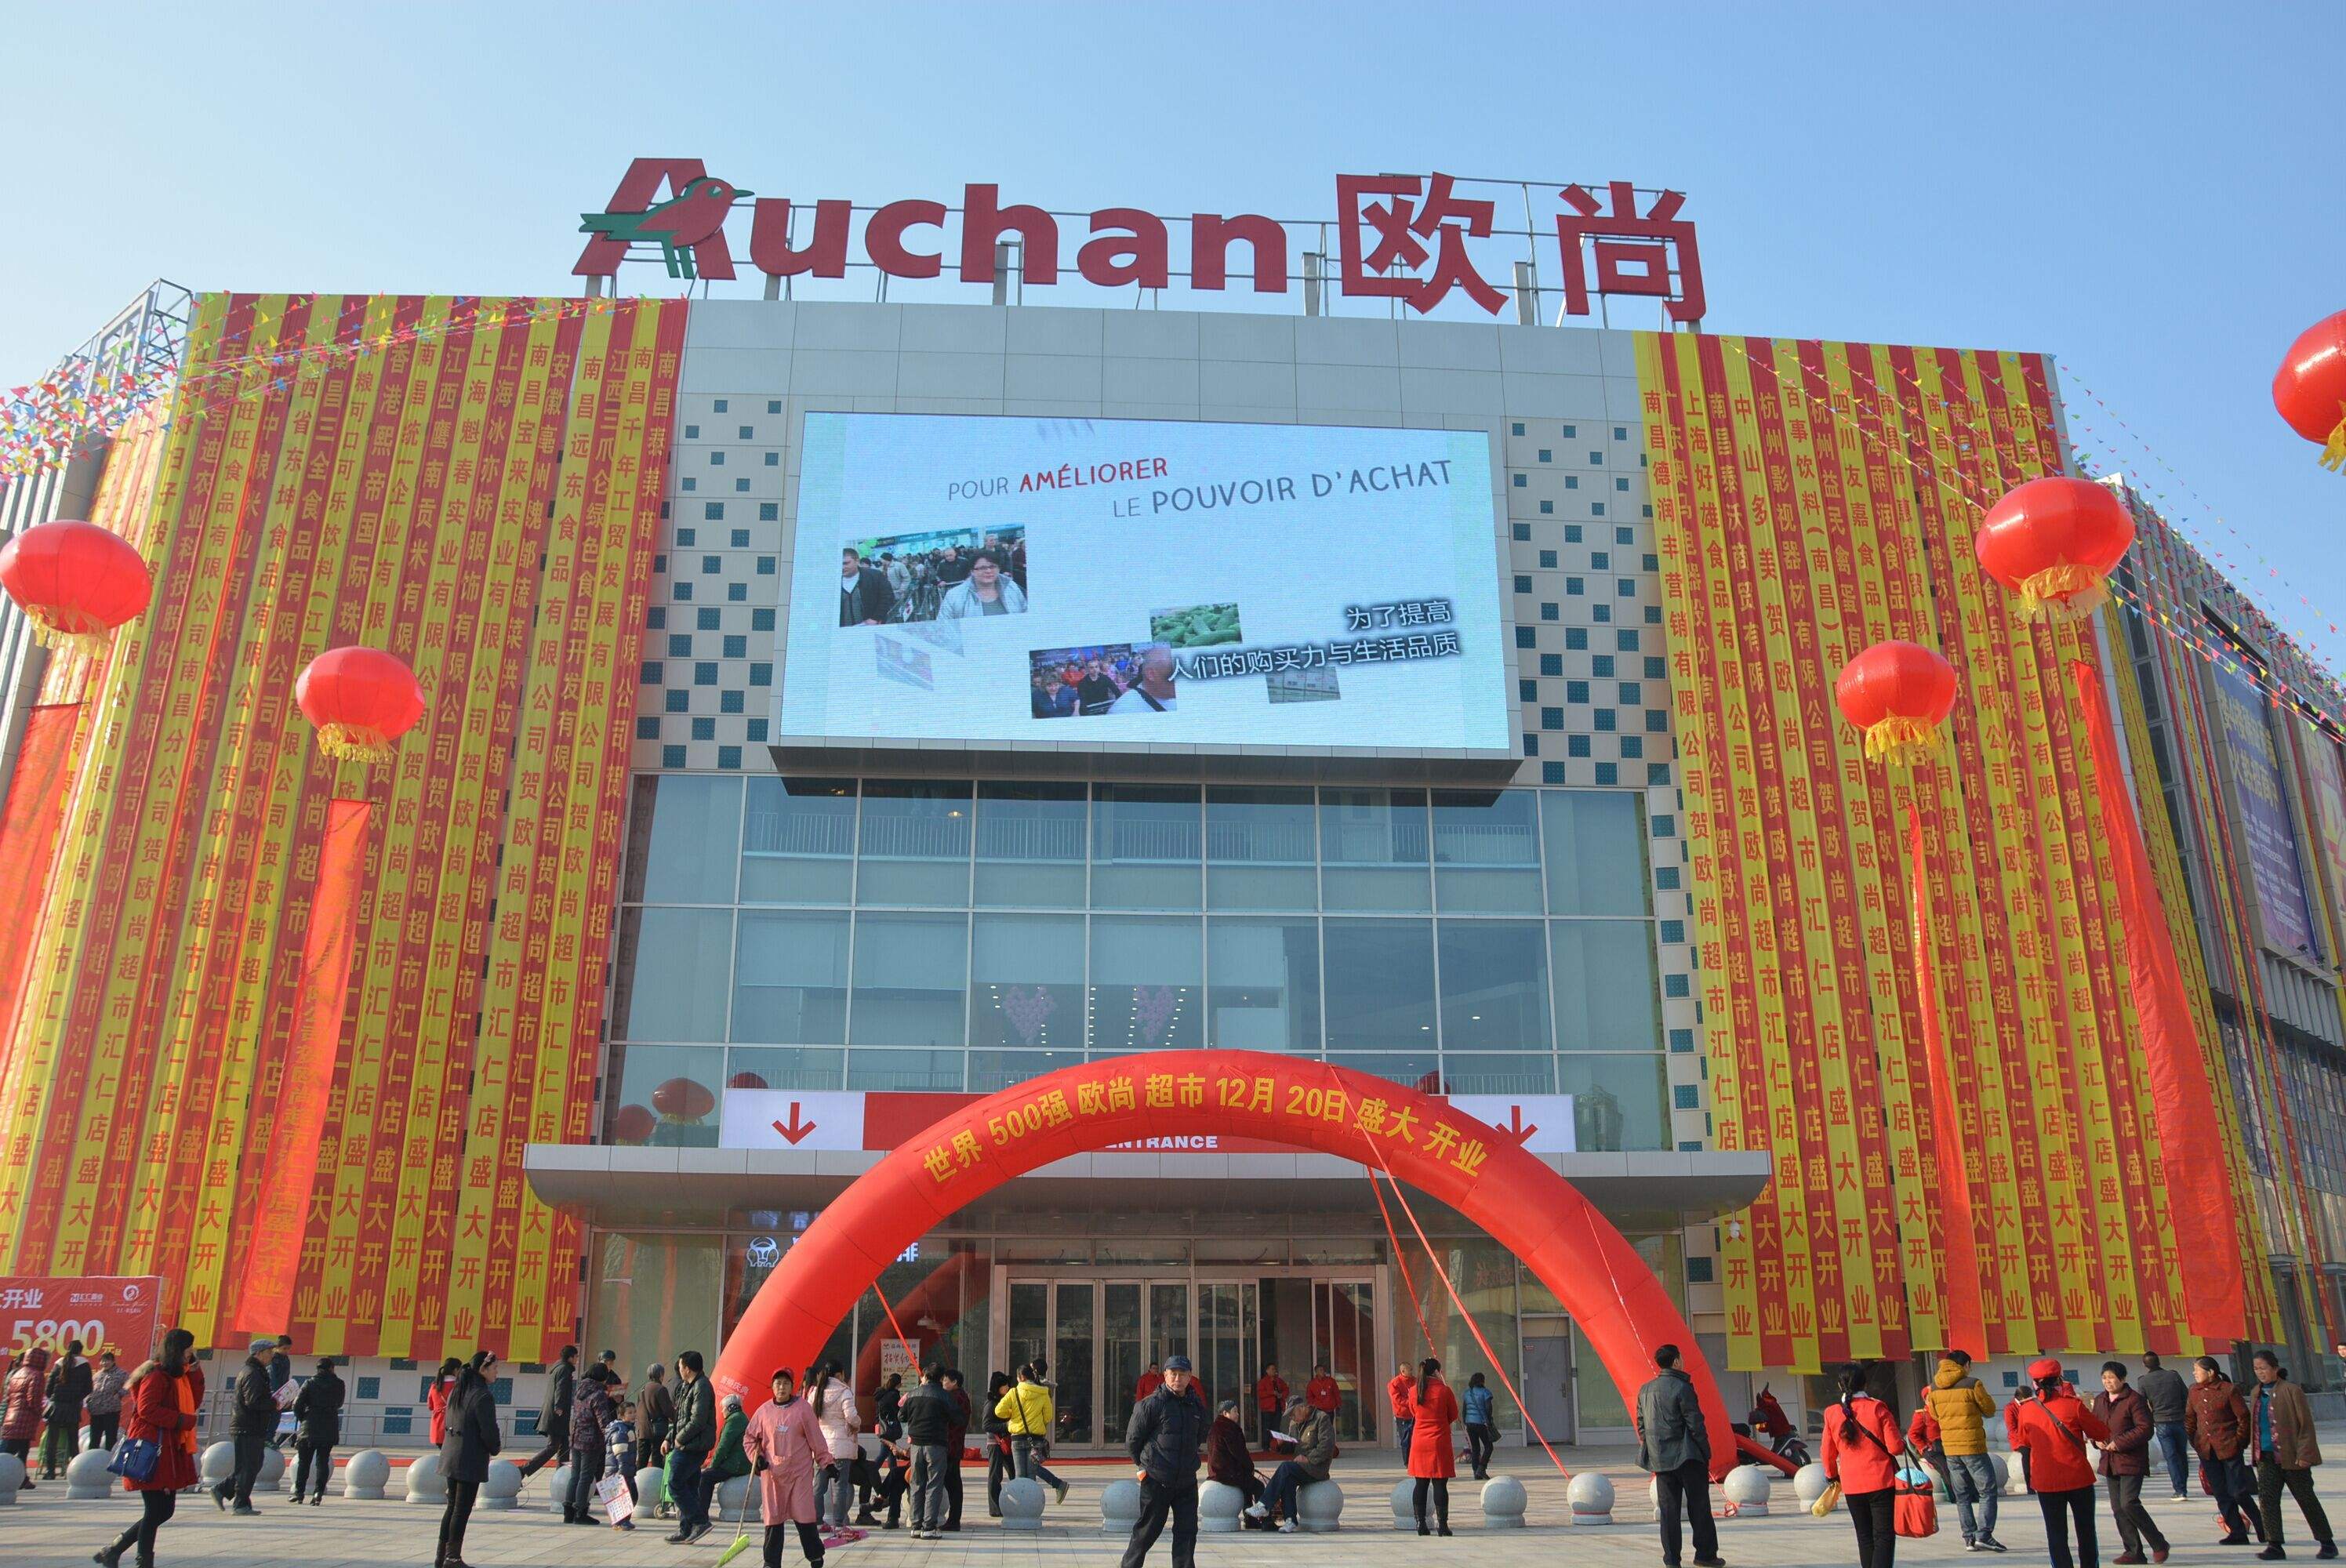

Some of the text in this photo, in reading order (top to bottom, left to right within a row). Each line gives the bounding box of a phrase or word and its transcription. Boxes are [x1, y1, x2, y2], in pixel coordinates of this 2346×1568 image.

[572, 158, 1710, 325] Auchan 欧尚
[947, 456, 1169, 503] POUR AMÉLIORER
[1113, 458, 1454, 518] LE POUVOIR D'ACHAT
[1346, 599, 1452, 632] 为了提高
[1168, 632, 1461, 682] 人们的购买力与生活品质
[517, 347, 653, 1327] 南昌千年工贸发展有限公司贺欧尚超市汇仁店大开业
[1733, 393, 1873, 1325] 中山多美贺欧尚超市汇仁店盛大开业
[923, 1073, 1487, 1182] 世界 500强 欧尚 超市 12月 20日 盛大 开业
[0, 1288, 43, 1309] 开业
[9, 1319, 104, 1356] 5800
